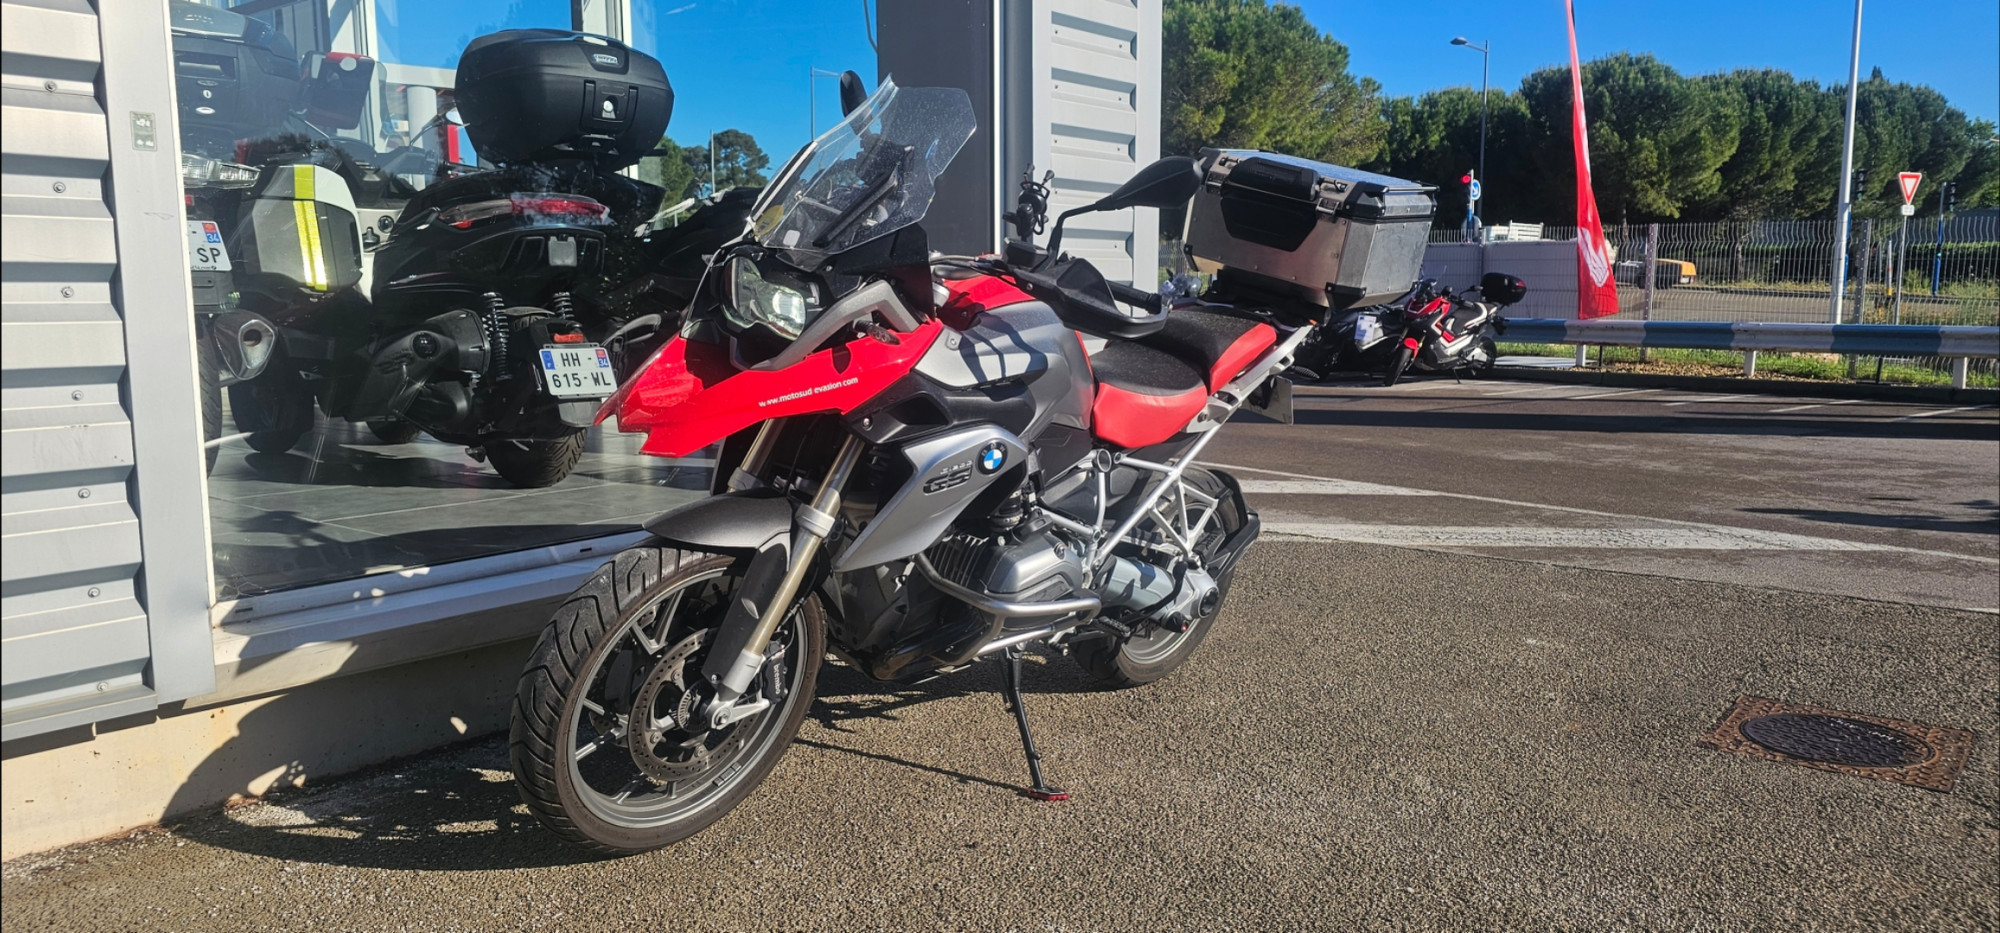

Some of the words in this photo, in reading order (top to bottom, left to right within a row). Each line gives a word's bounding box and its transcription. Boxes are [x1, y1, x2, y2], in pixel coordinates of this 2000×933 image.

[206, 233, 219, 242] 34
[197, 248, 220, 263] SP
[560, 353, 581, 367] HH
[599, 359, 608, 367] 34
[552, 372, 611, 388] 615-WL
